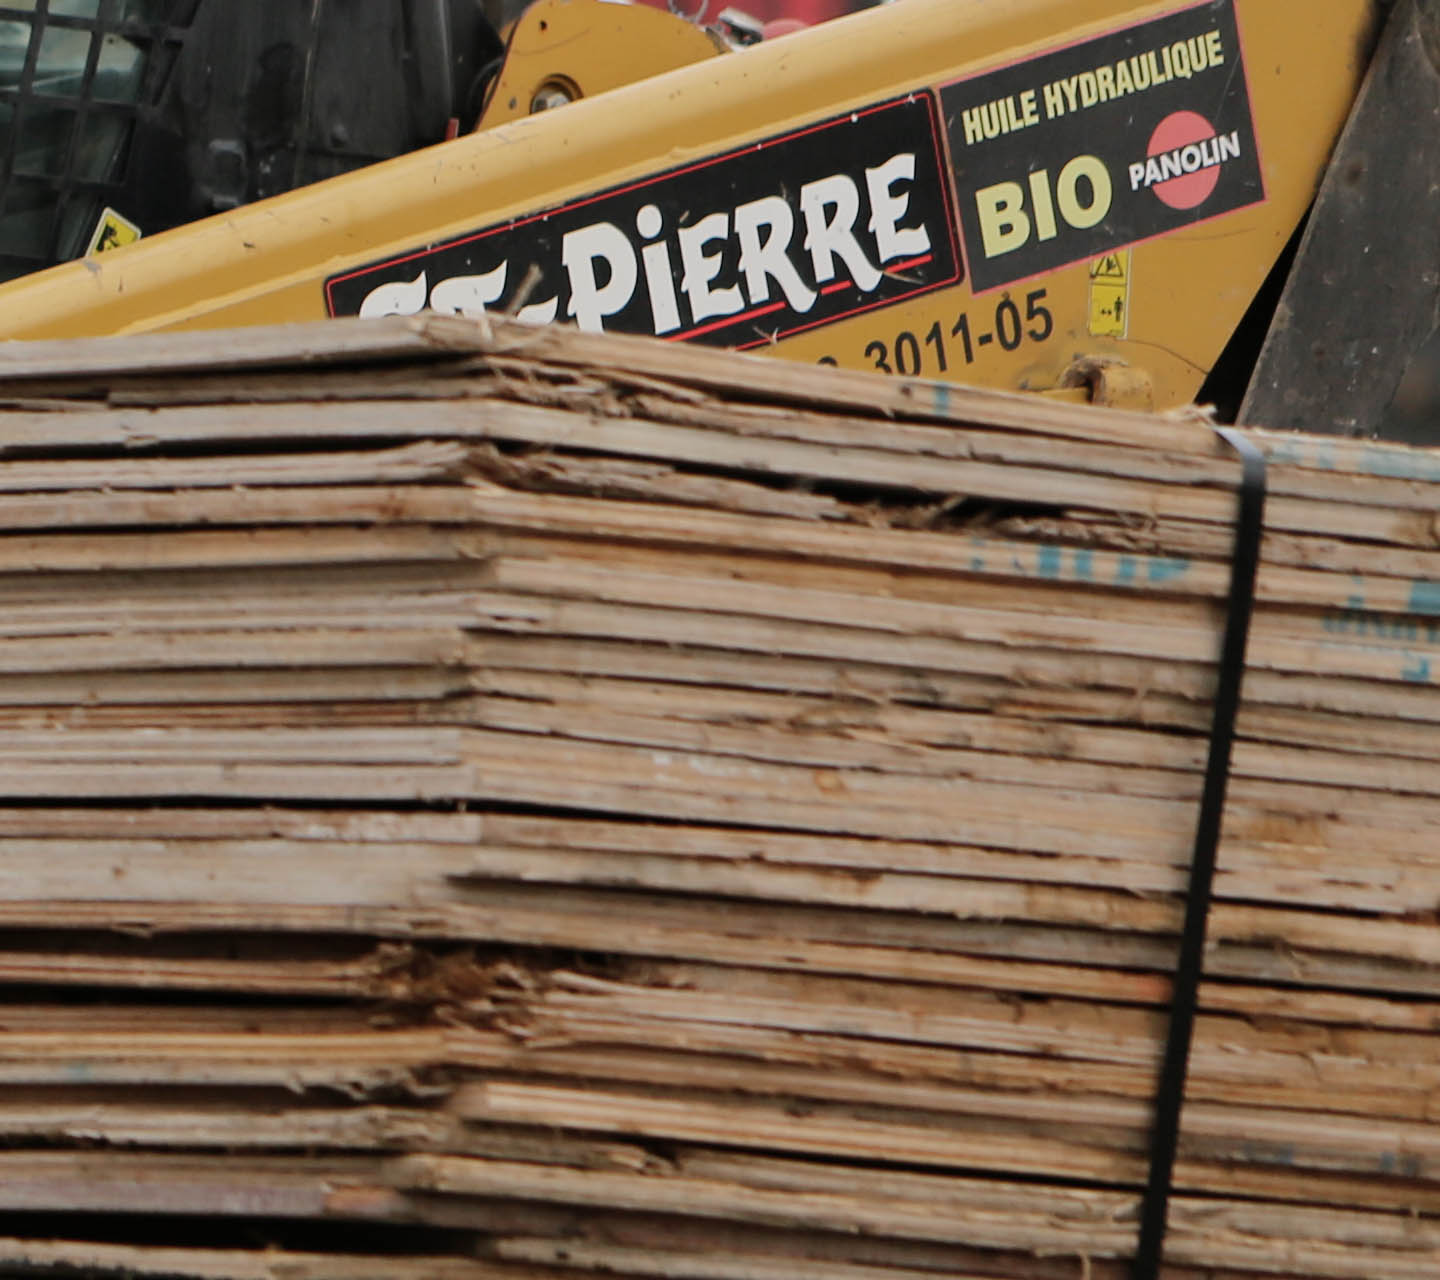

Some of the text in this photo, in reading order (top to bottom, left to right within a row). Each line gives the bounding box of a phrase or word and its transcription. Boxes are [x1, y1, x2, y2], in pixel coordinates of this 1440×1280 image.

[961, 29, 1225, 146] HUILE HYDRAULIQUE
[974, 153, 1113, 260] BIO
[1128, 130, 1242, 193] PANOLIN
